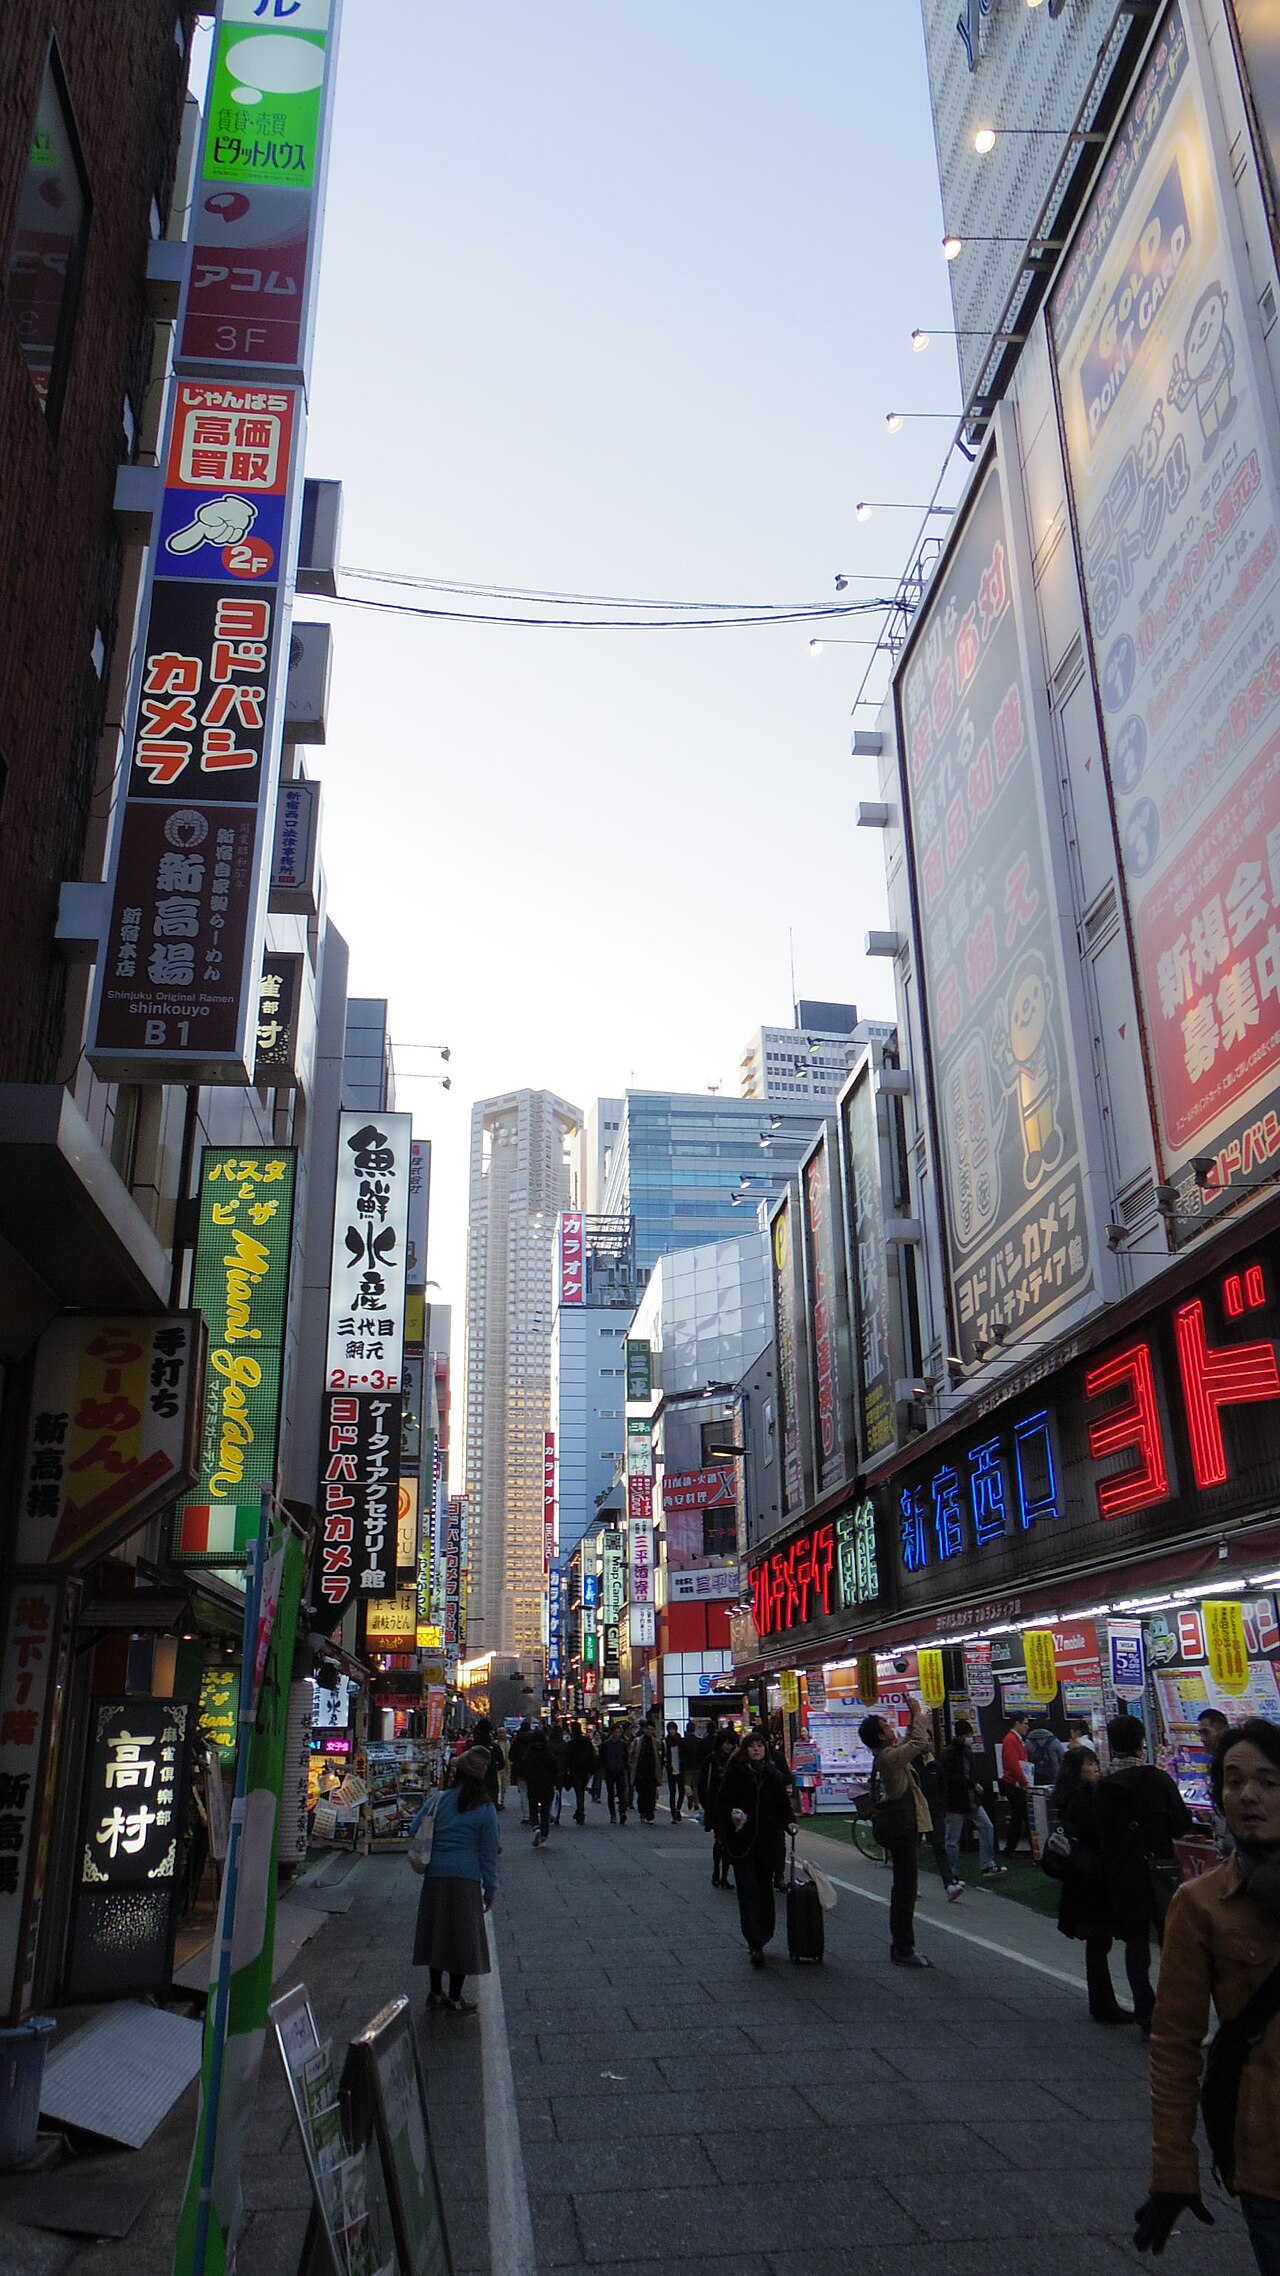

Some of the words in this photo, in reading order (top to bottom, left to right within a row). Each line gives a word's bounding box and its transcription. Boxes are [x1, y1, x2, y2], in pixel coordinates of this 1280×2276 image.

[214, 136, 305, 170] ピタットハウス
[218, 108, 287, 137] 賃貸・売買
[194, 264, 297, 296] アコム
[1099, 216, 1162, 359] GOLD
[215, 325, 268, 353] 3F
[190, 450, 268, 482] 買取
[192, 415, 272, 450] 高価
[1085, 398, 1165, 552] ココが
[228, 546, 268, 573] 2F
[200, 598, 272, 773] ヨドバシ
[912, 539, 1006, 790] 接客応対
[134, 651, 203, 785] カメラ
[279, 790, 301, 876] 新宿西口法律事務所
[922, 682, 1025, 914] 商品知識
[115, 907, 143, 978] 新宿本店
[203, 828, 236, 982] 新宿自家製らーめん
[935, 851, 1037, 1050] 品揃え
[107, 990, 152, 1001] Shinjuku
[155, 992, 196, 1002] Original
[199, 993, 234, 1004] Ramen
[128, 1001, 210, 1017] shinkouyo
[208, 1160, 286, 1182] パスタ
[212, 1200, 277, 1226] ピザ
[238, 1184, 254, 1199] と
[345, 1125, 399, 1312] 魚鮮水産
[562, 1219, 581, 1296] カラオケ
[958, 1182, 1078, 1325] ヨドバシカメラ
[222, 1230, 271, 1344] Miami
[337, 1318, 395, 1339] 三代目
[975, 1234, 1084, 1342] マルチメディア館
[150, 1327, 186, 1418] 手打ち
[345, 1340, 385, 1360] 網元
[68, 1326, 145, 1473] らーめん
[322, 1397, 361, 1604] ヨドバシカメラ
[360, 1399, 392, 1589] ケータイアクセサリー館
[900, 1409, 1060, 1573] 新宿西口
[611, 1555, 621, 1580] Map
[612, 1581, 622, 1624] Camera
[96, 1730, 157, 1860] 高村
